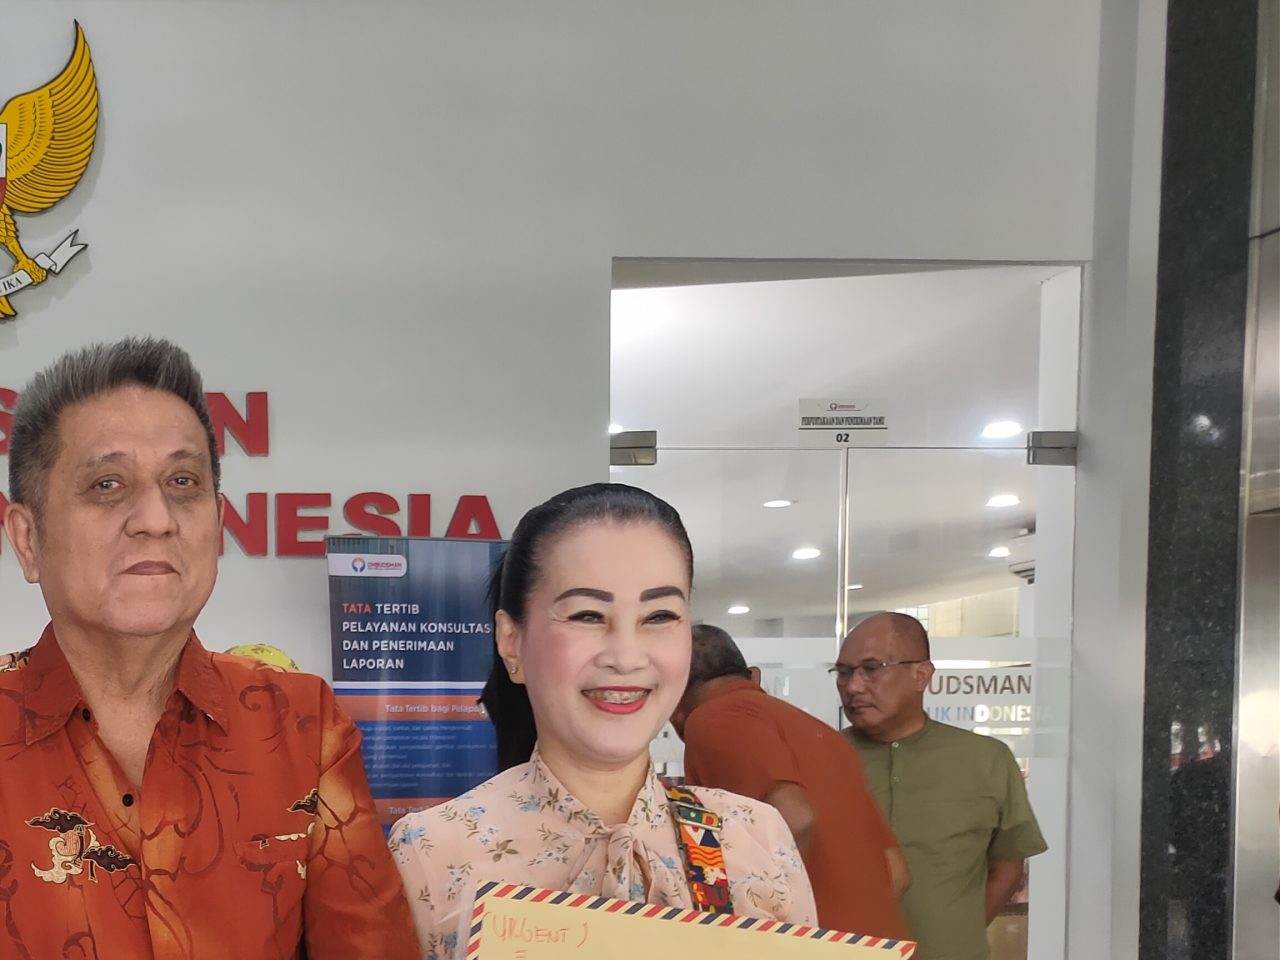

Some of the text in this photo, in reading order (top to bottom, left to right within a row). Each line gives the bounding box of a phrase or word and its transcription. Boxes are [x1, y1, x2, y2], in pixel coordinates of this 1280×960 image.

[2, 277, 22, 290] IKA
[836, 433, 850, 443] 02
[342, 603, 420, 615] TATA TERTIB
[342, 621, 491, 634] PELAYANAN KONSULTAS
[342, 640, 454, 652] DAN PENERIMAAN
[343, 658, 404, 670] LAPORAN
[928, 674, 1032, 695] UDSMAN
[385, 704, 403, 713] Tata
[452, 704, 481, 715] Pelapo
